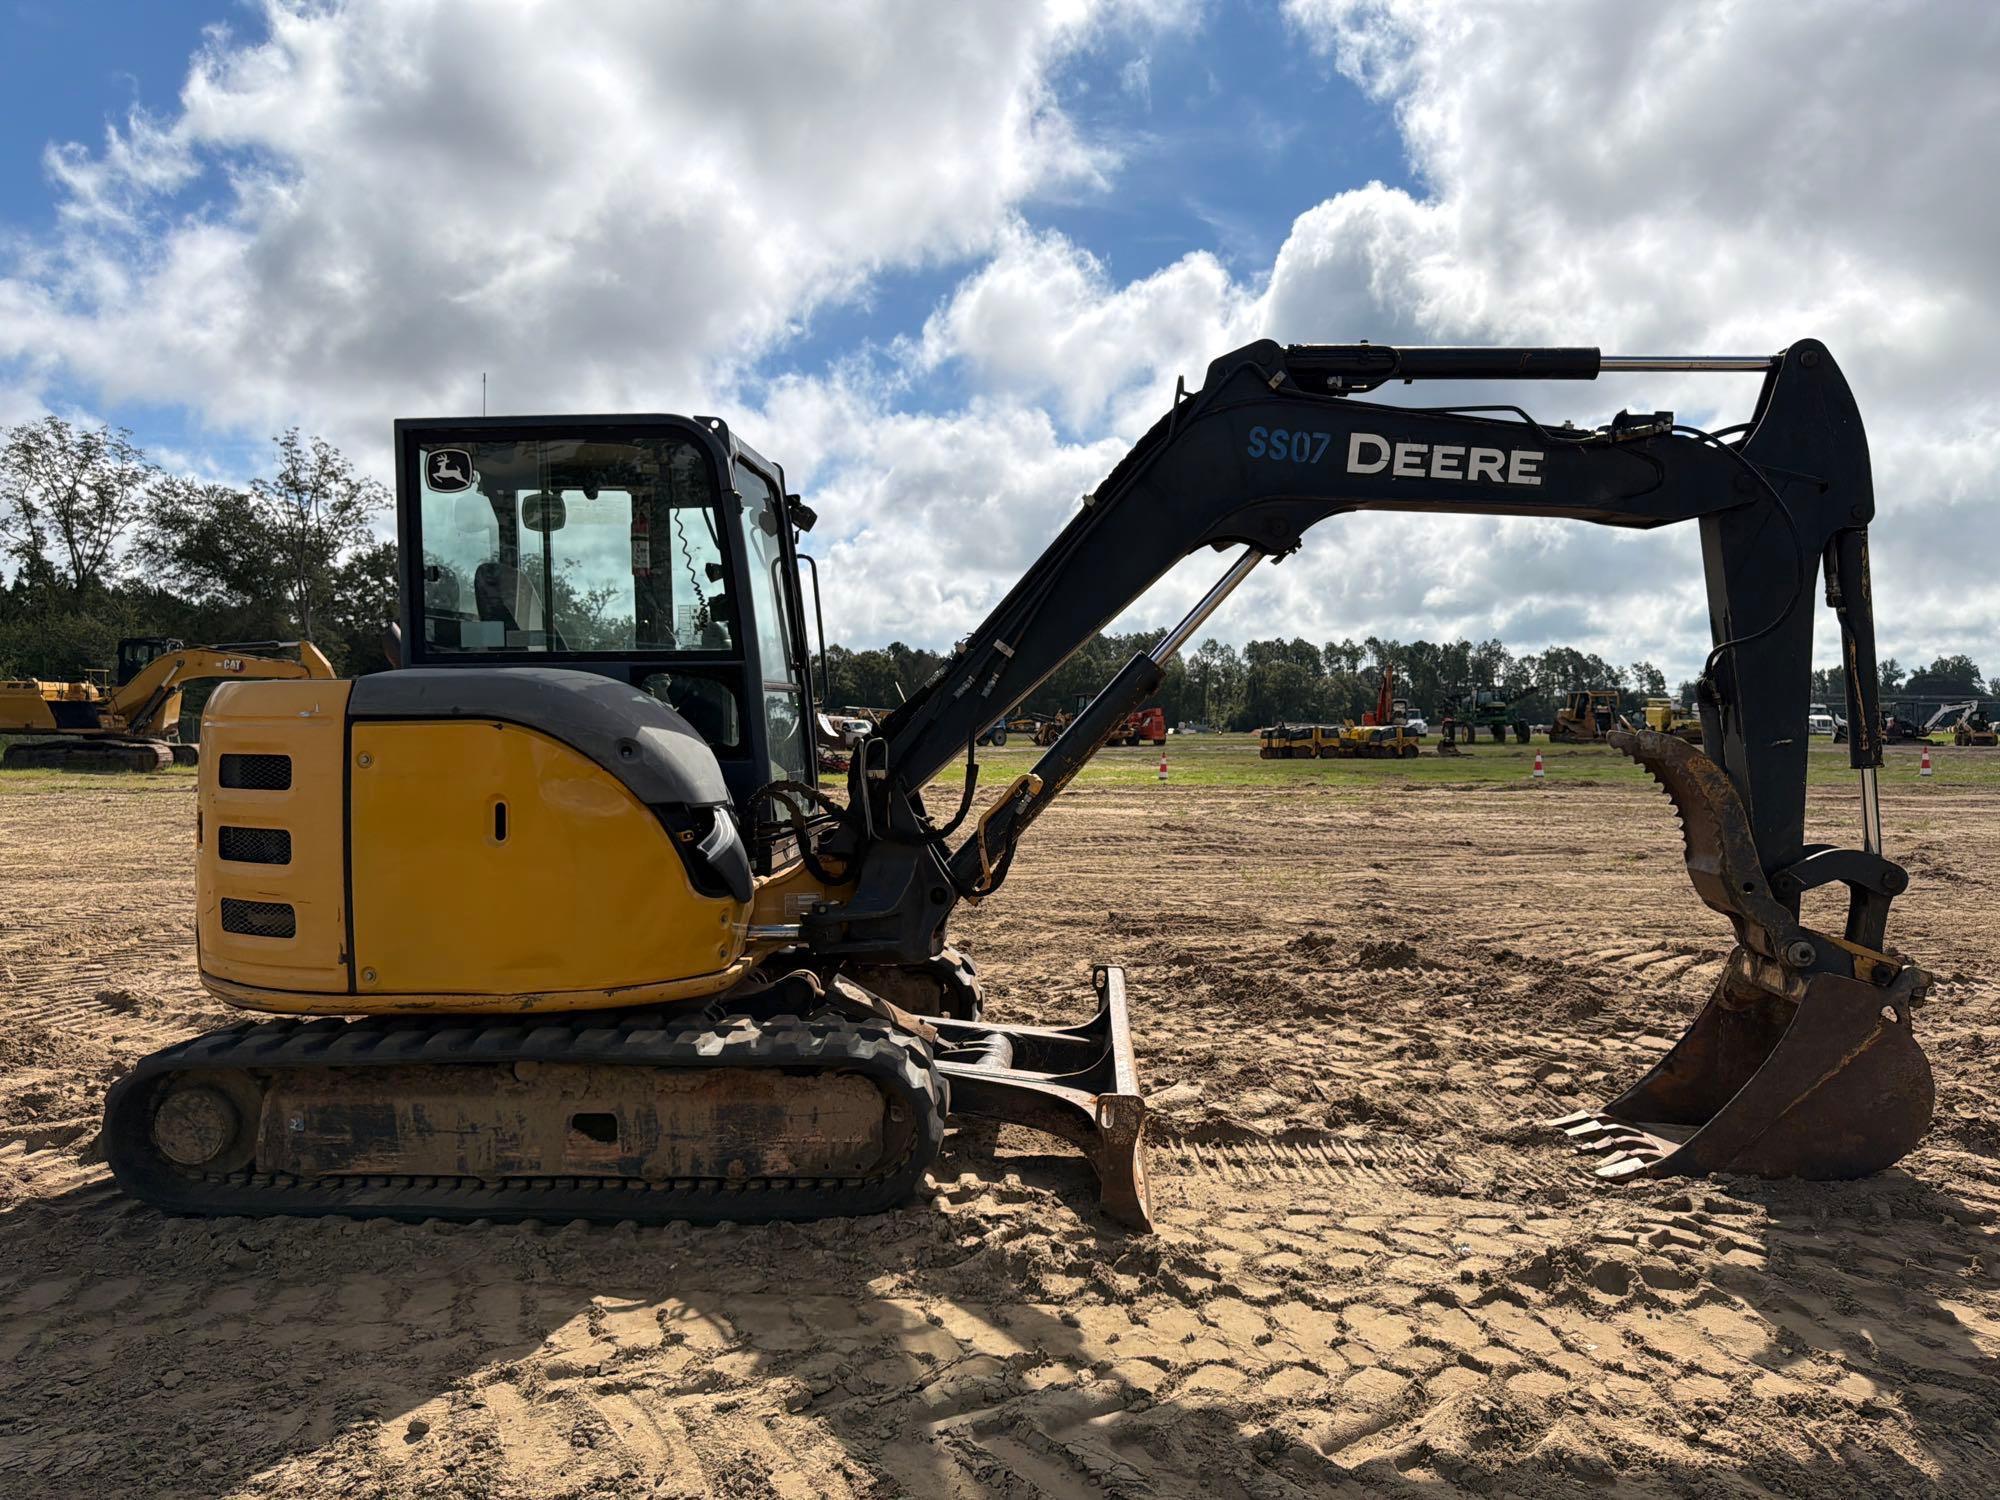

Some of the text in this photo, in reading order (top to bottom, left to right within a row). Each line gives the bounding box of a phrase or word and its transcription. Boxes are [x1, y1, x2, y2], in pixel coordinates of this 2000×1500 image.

[1247, 425, 1331, 465] SS07
[1347, 432, 1544, 486] DEERE
[224, 659, 241, 671] CAT
